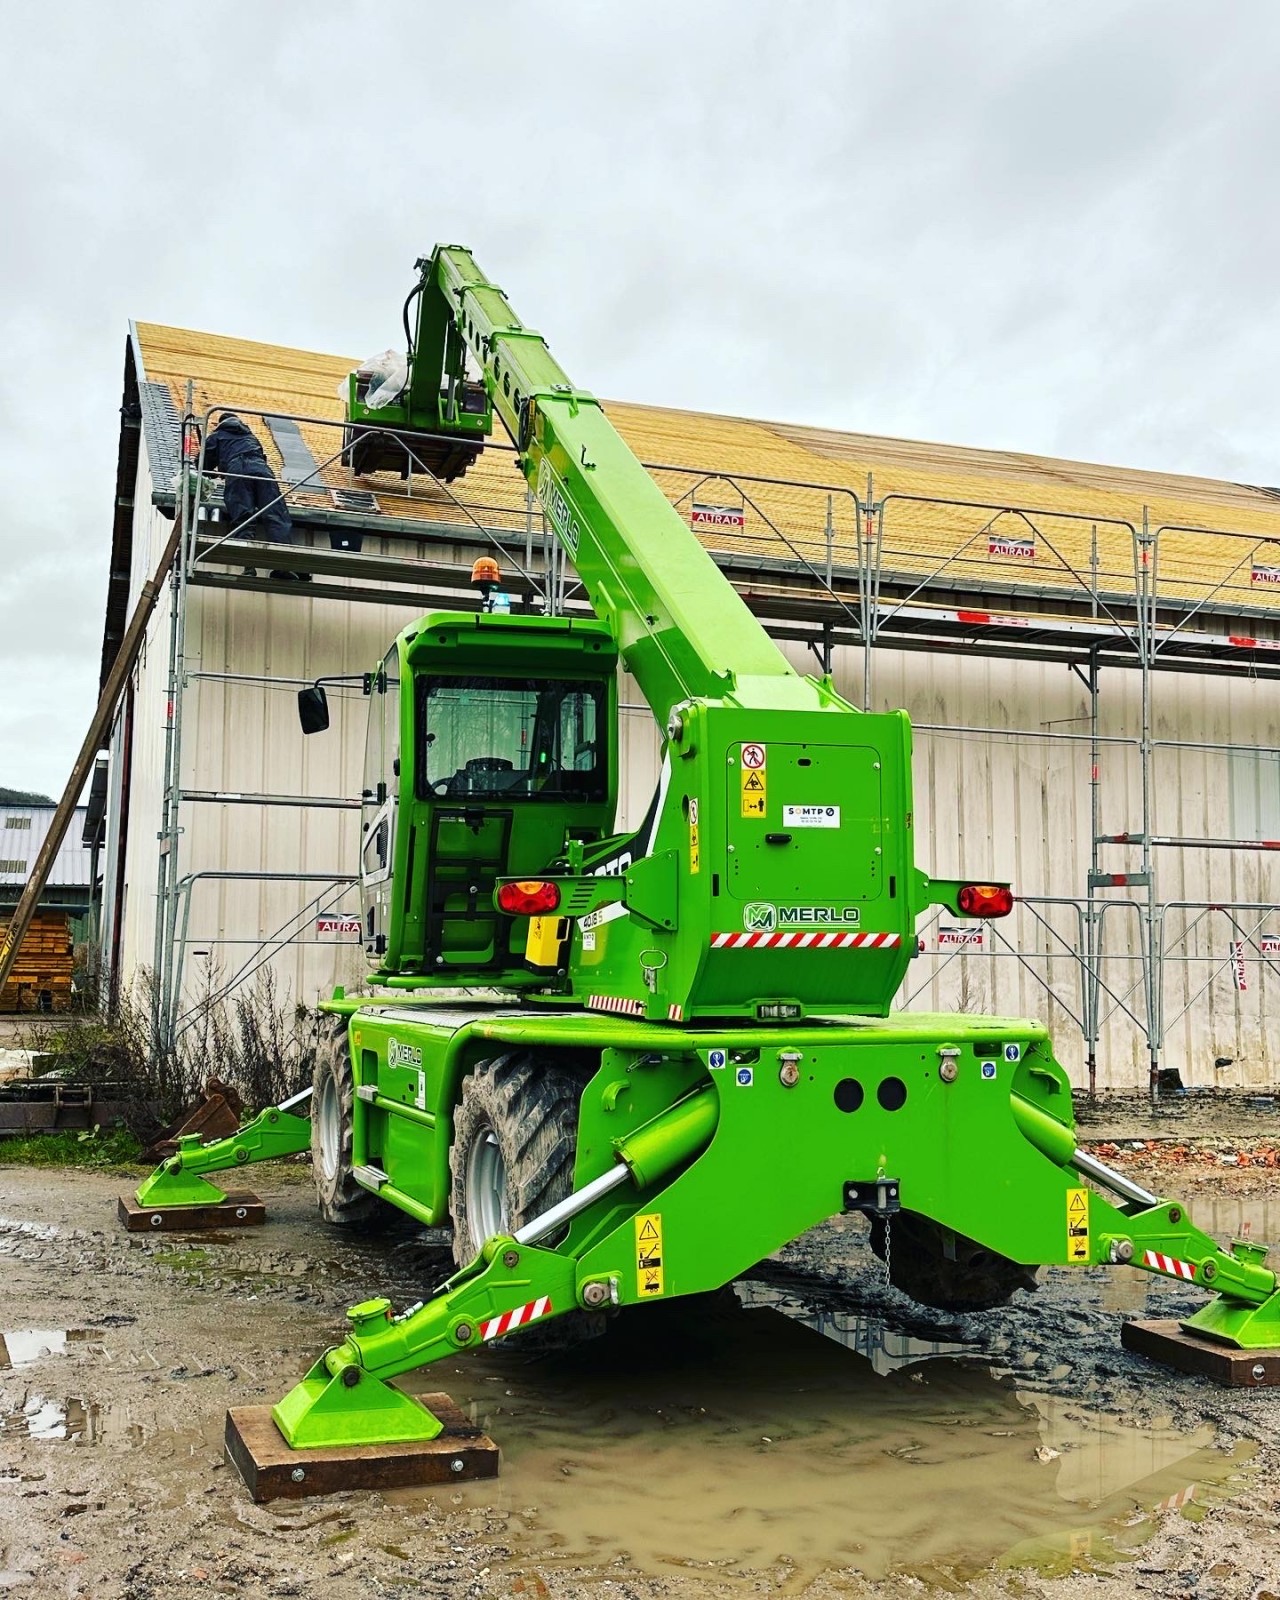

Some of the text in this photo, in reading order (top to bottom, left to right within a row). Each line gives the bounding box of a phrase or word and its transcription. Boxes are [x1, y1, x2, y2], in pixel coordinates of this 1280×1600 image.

[549, 480, 580, 551] MERLO
[697, 513, 740, 525] ALTRAD
[993, 545, 1031, 556] ALTRAD
[1255, 572, 1280, 583] ALTRA
[788, 807, 824, 815] SOMTP
[779, 907, 860, 922] MERLO
[321, 921, 361, 932] ALTRA
[1265, 942, 1280, 952] ALT
[397, 1043, 422, 1066] MERLO
